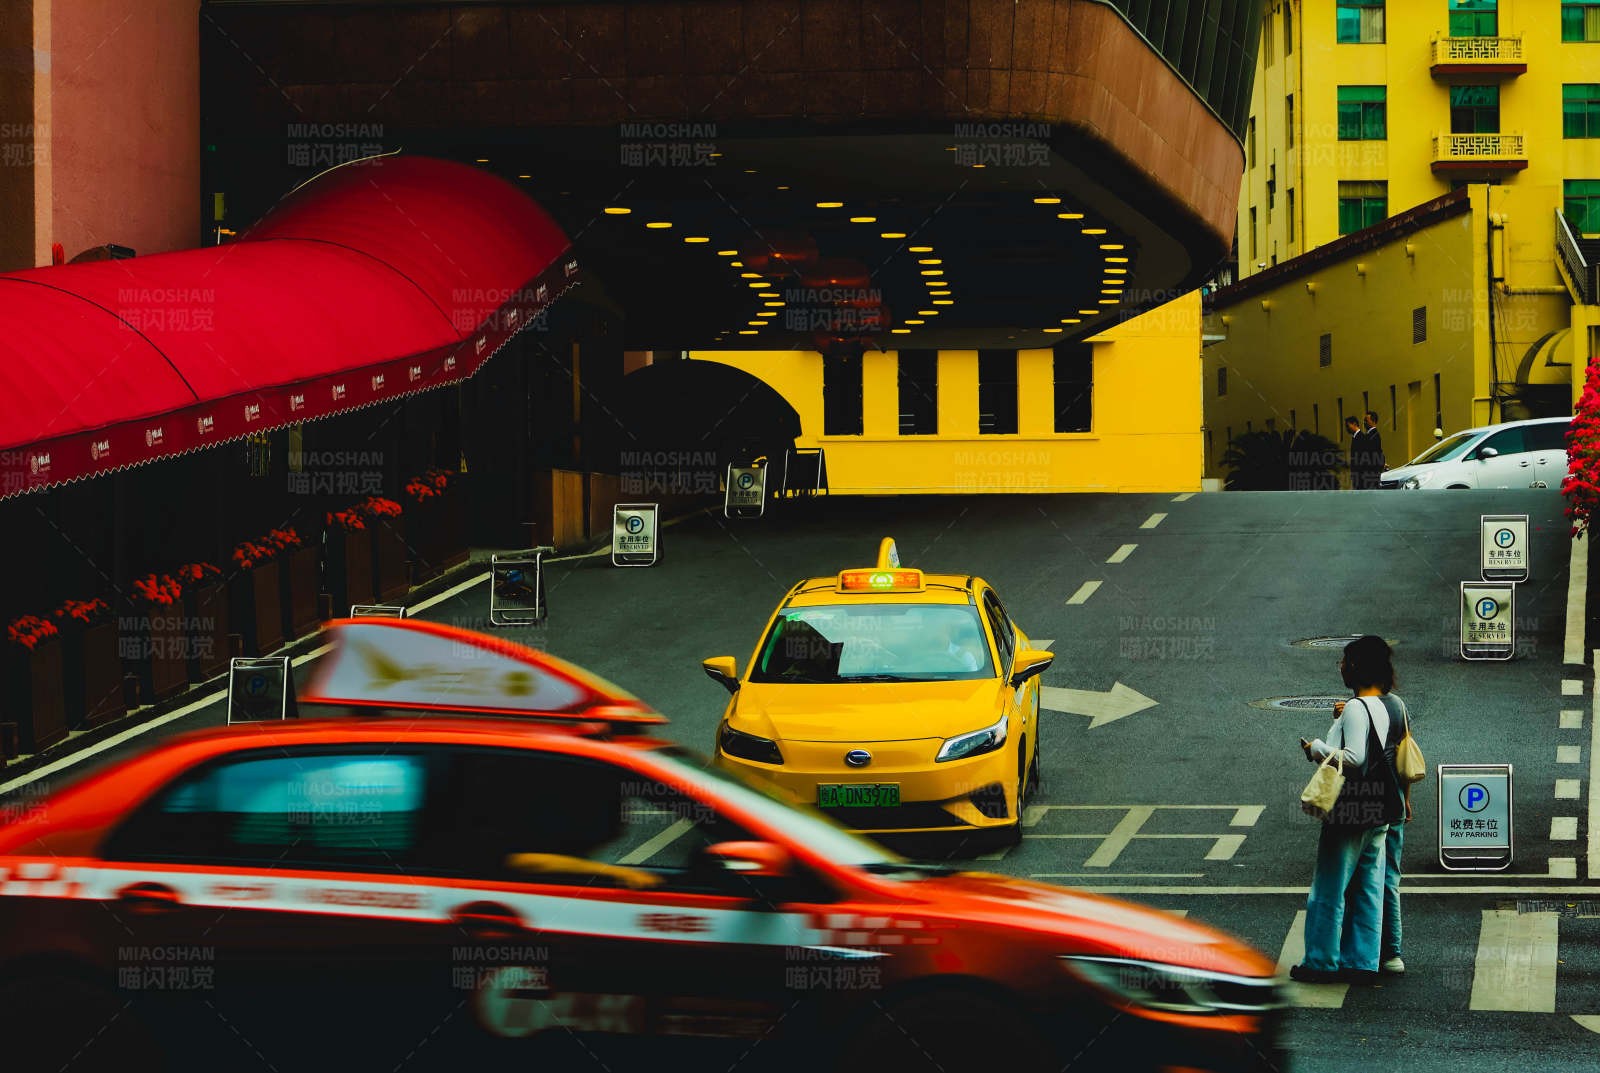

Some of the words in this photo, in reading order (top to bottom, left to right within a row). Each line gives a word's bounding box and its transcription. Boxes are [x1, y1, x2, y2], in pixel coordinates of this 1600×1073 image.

[1488, 549, 1521, 558] 专用车位
[1468, 622, 1506, 631] 专用车位
[1467, 631, 1506, 639] RESERVED
[1450, 818, 1498, 830] 收费车位
